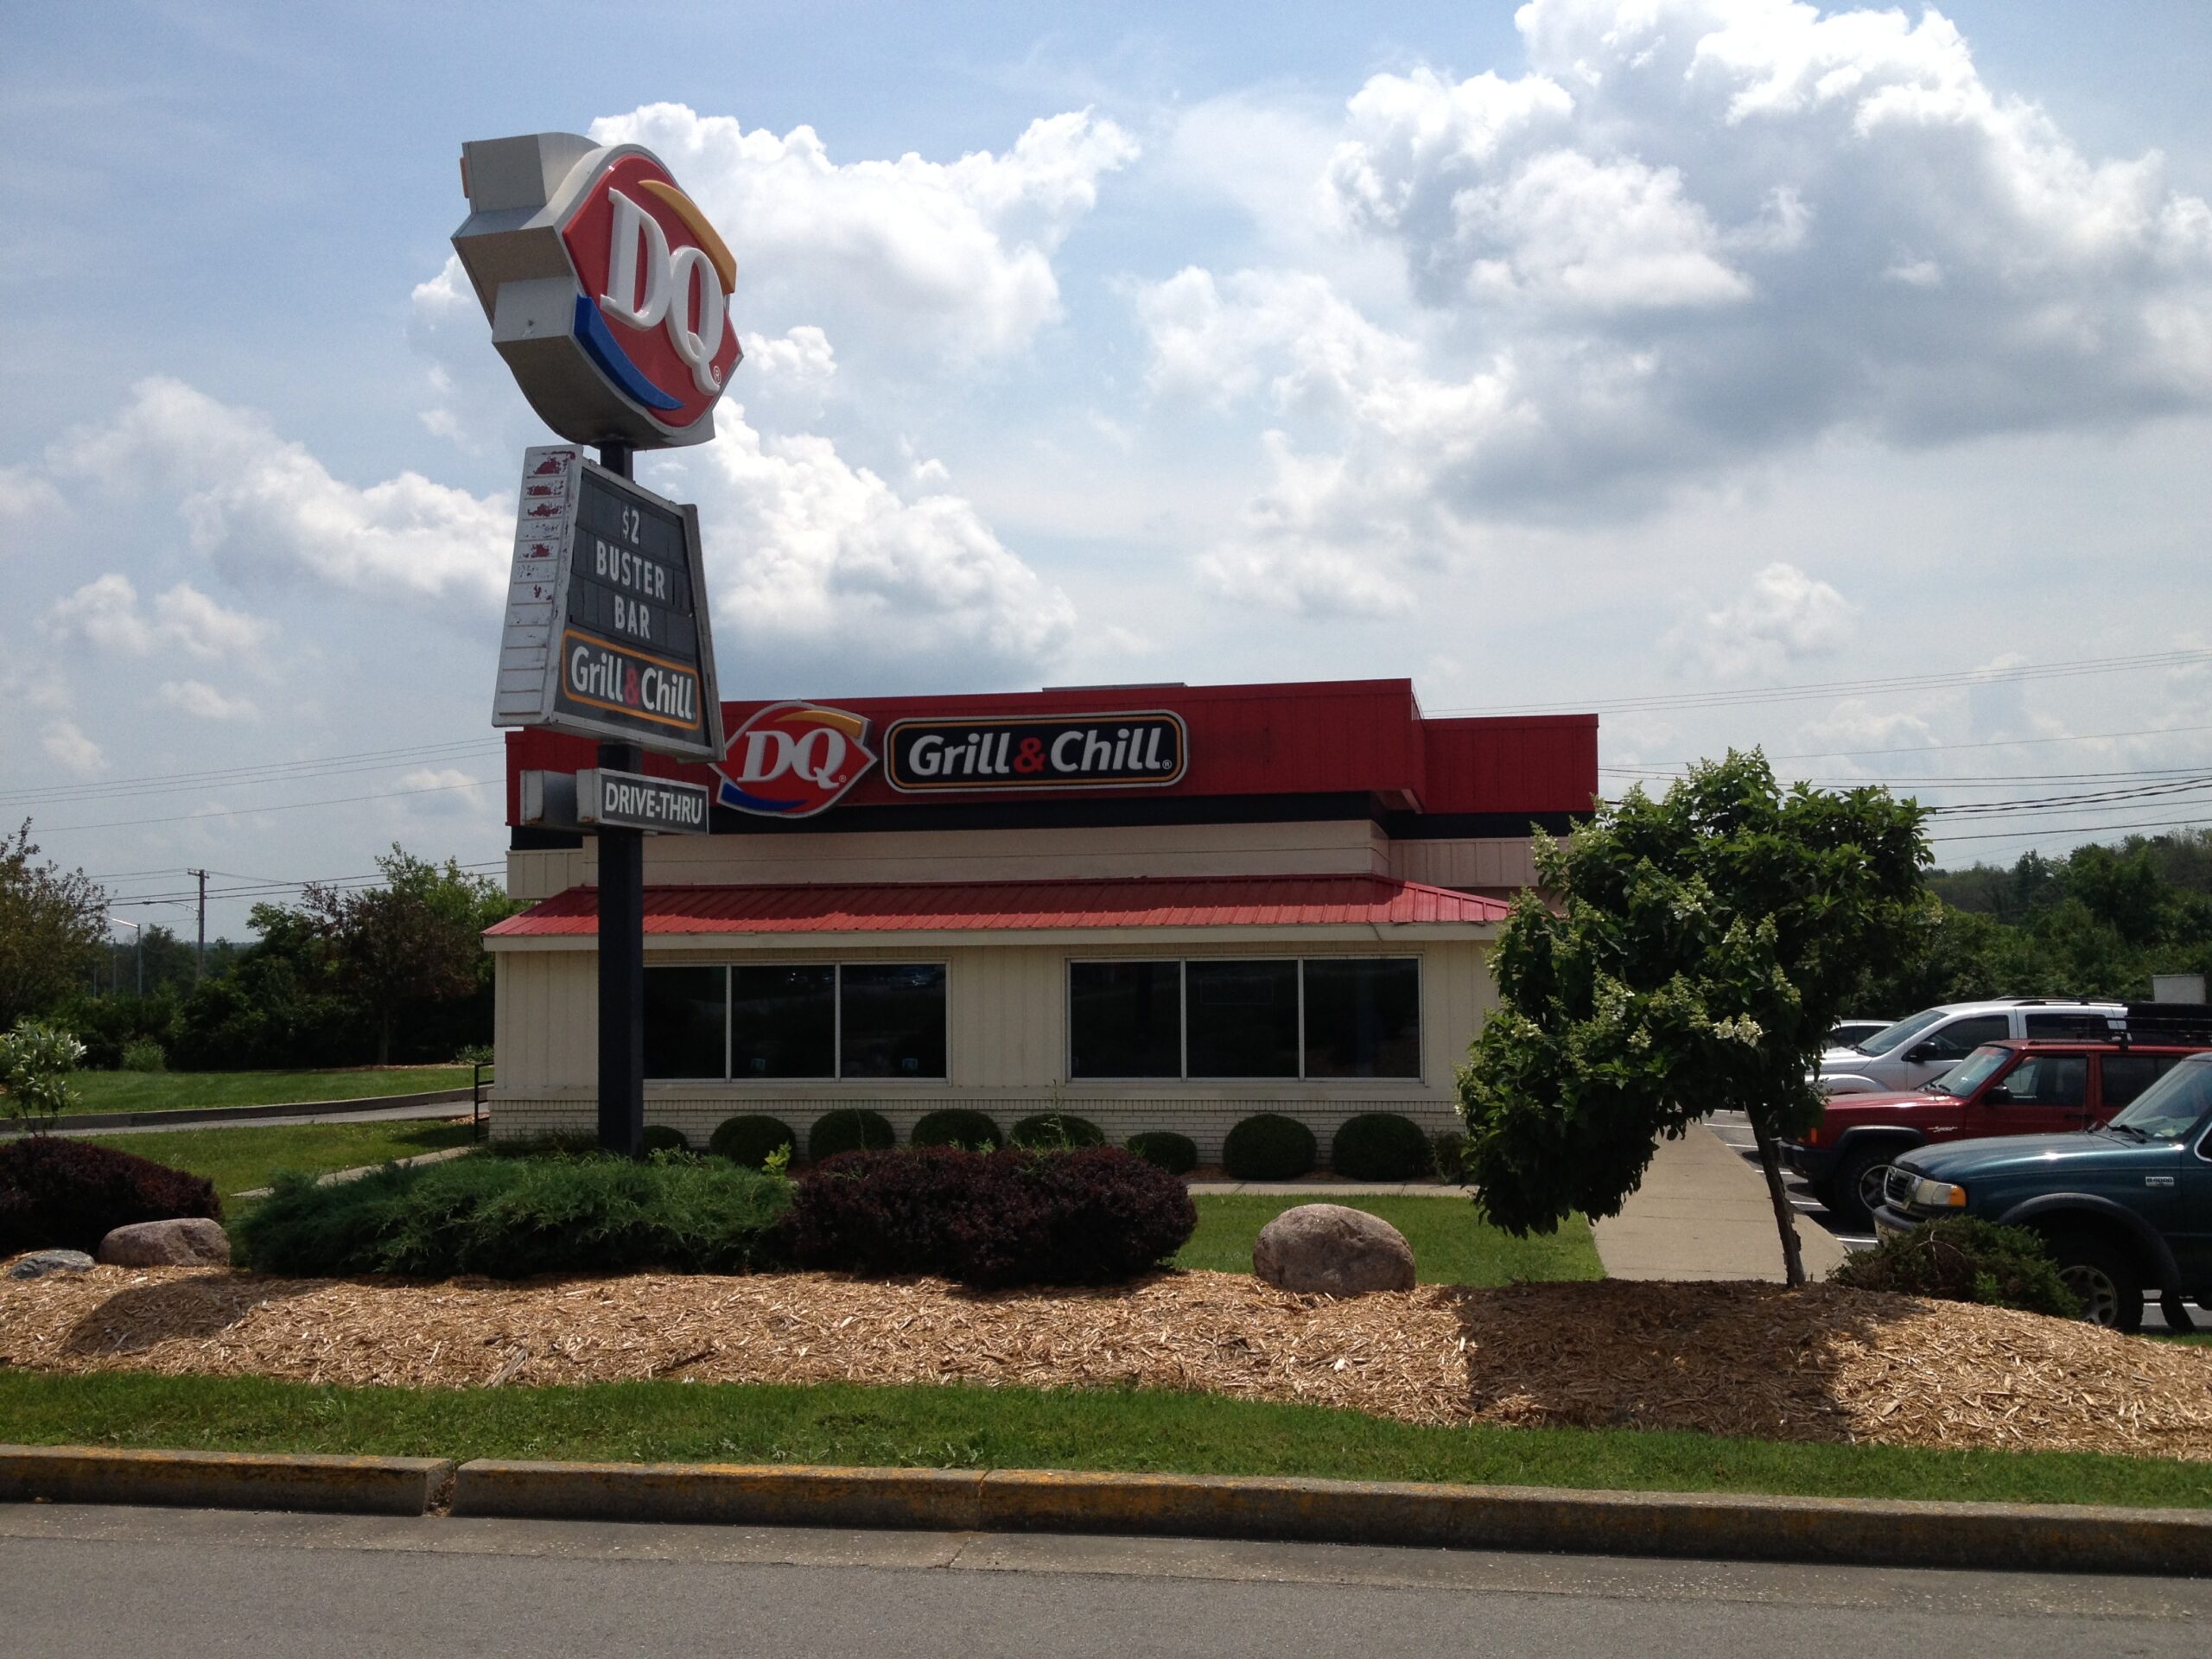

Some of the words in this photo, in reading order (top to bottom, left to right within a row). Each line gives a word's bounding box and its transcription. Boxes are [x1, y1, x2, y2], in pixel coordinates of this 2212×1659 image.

[601, 187, 724, 396] DQ
[621, 505, 639, 544] $2
[596, 540, 665, 600] BUSTER
[614, 594, 651, 639] BAR
[737, 728, 846, 788] DQ
[605, 782, 702, 824] DRIVE-THRU
